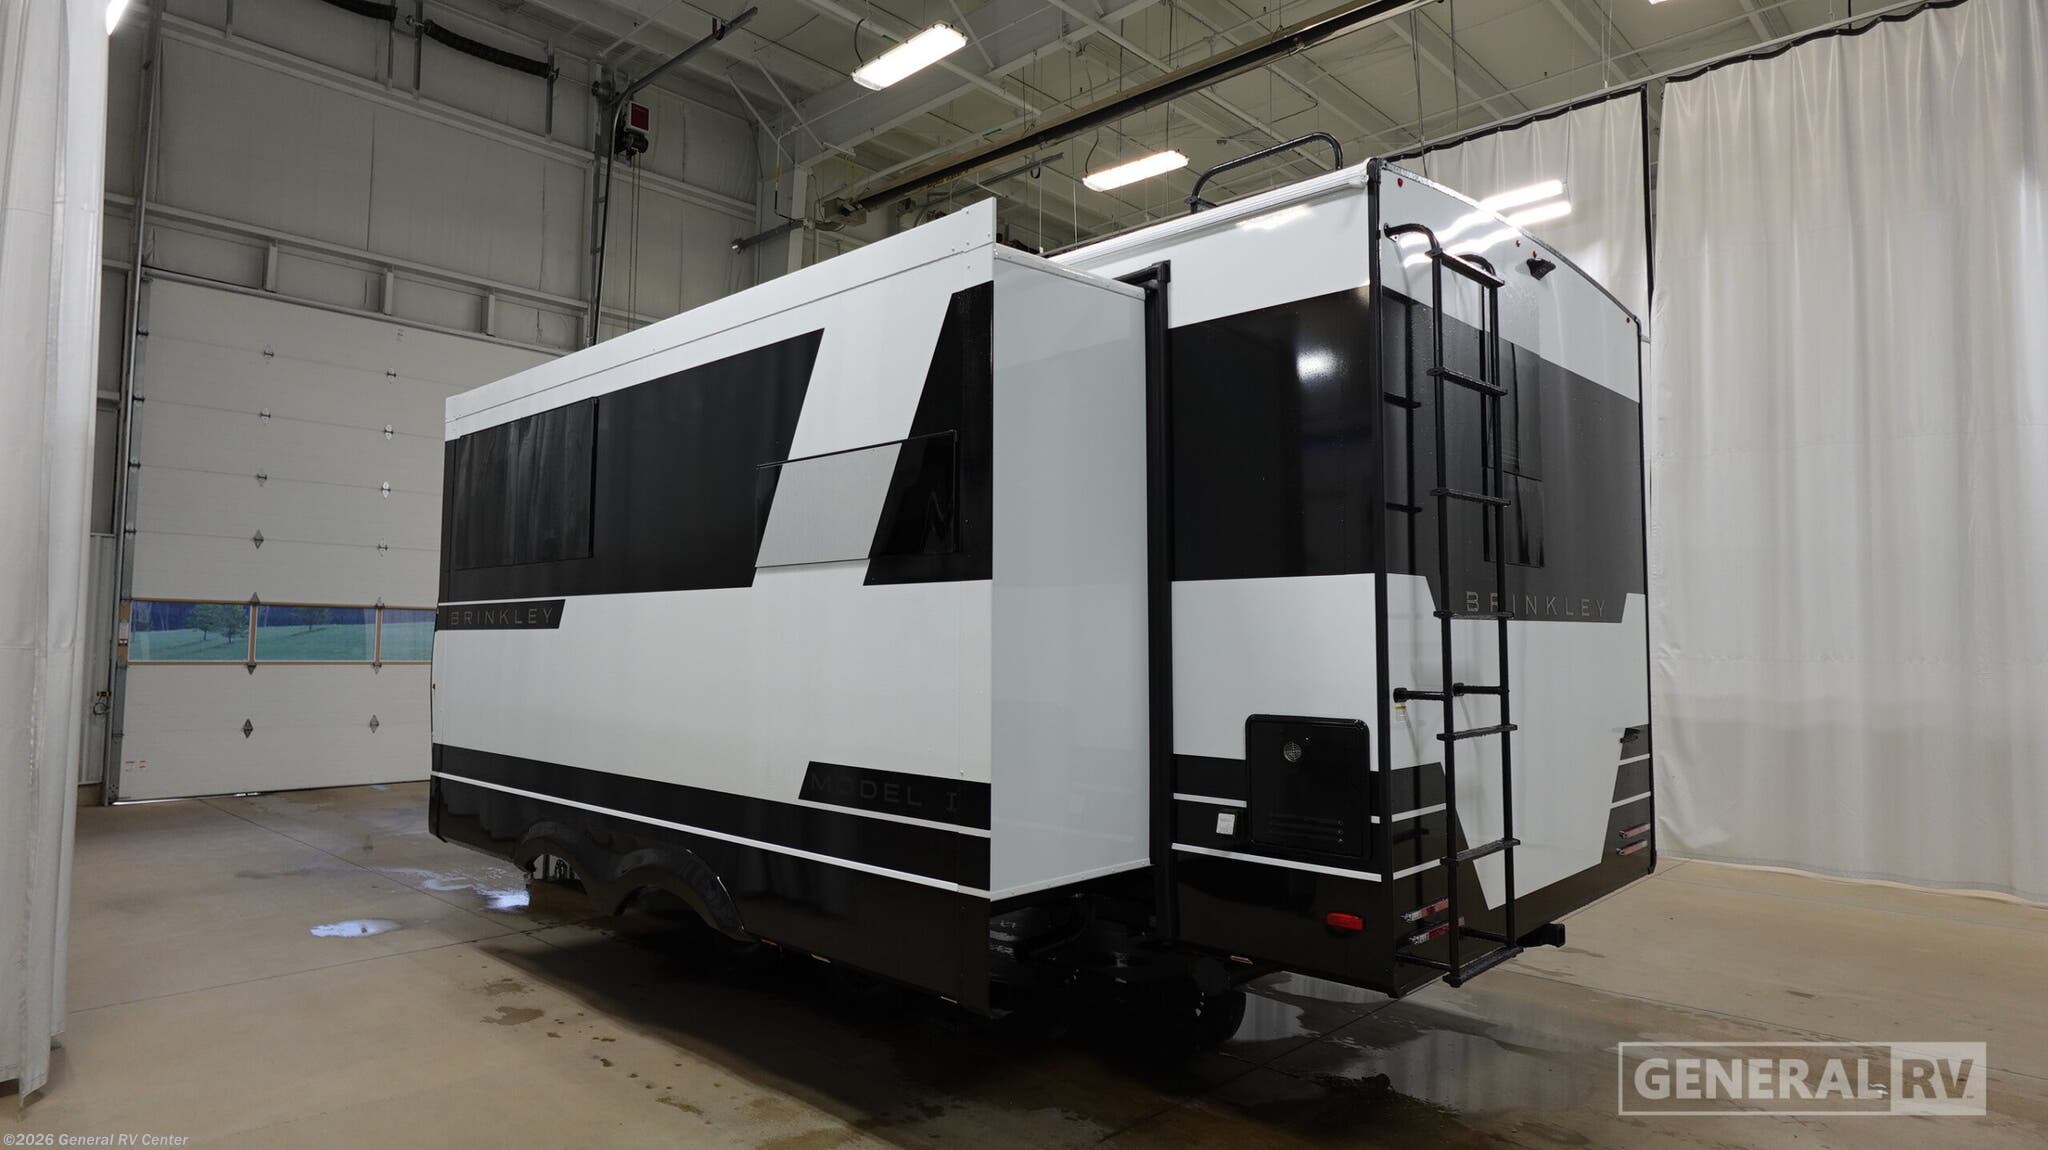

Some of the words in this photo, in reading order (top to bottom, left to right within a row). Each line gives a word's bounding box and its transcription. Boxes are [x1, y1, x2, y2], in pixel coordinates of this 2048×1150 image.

[450, 608, 553, 626] BRINKLEY
[1466, 590, 1606, 617] BRINKLEY
[810, 771, 922, 807] MODEL
